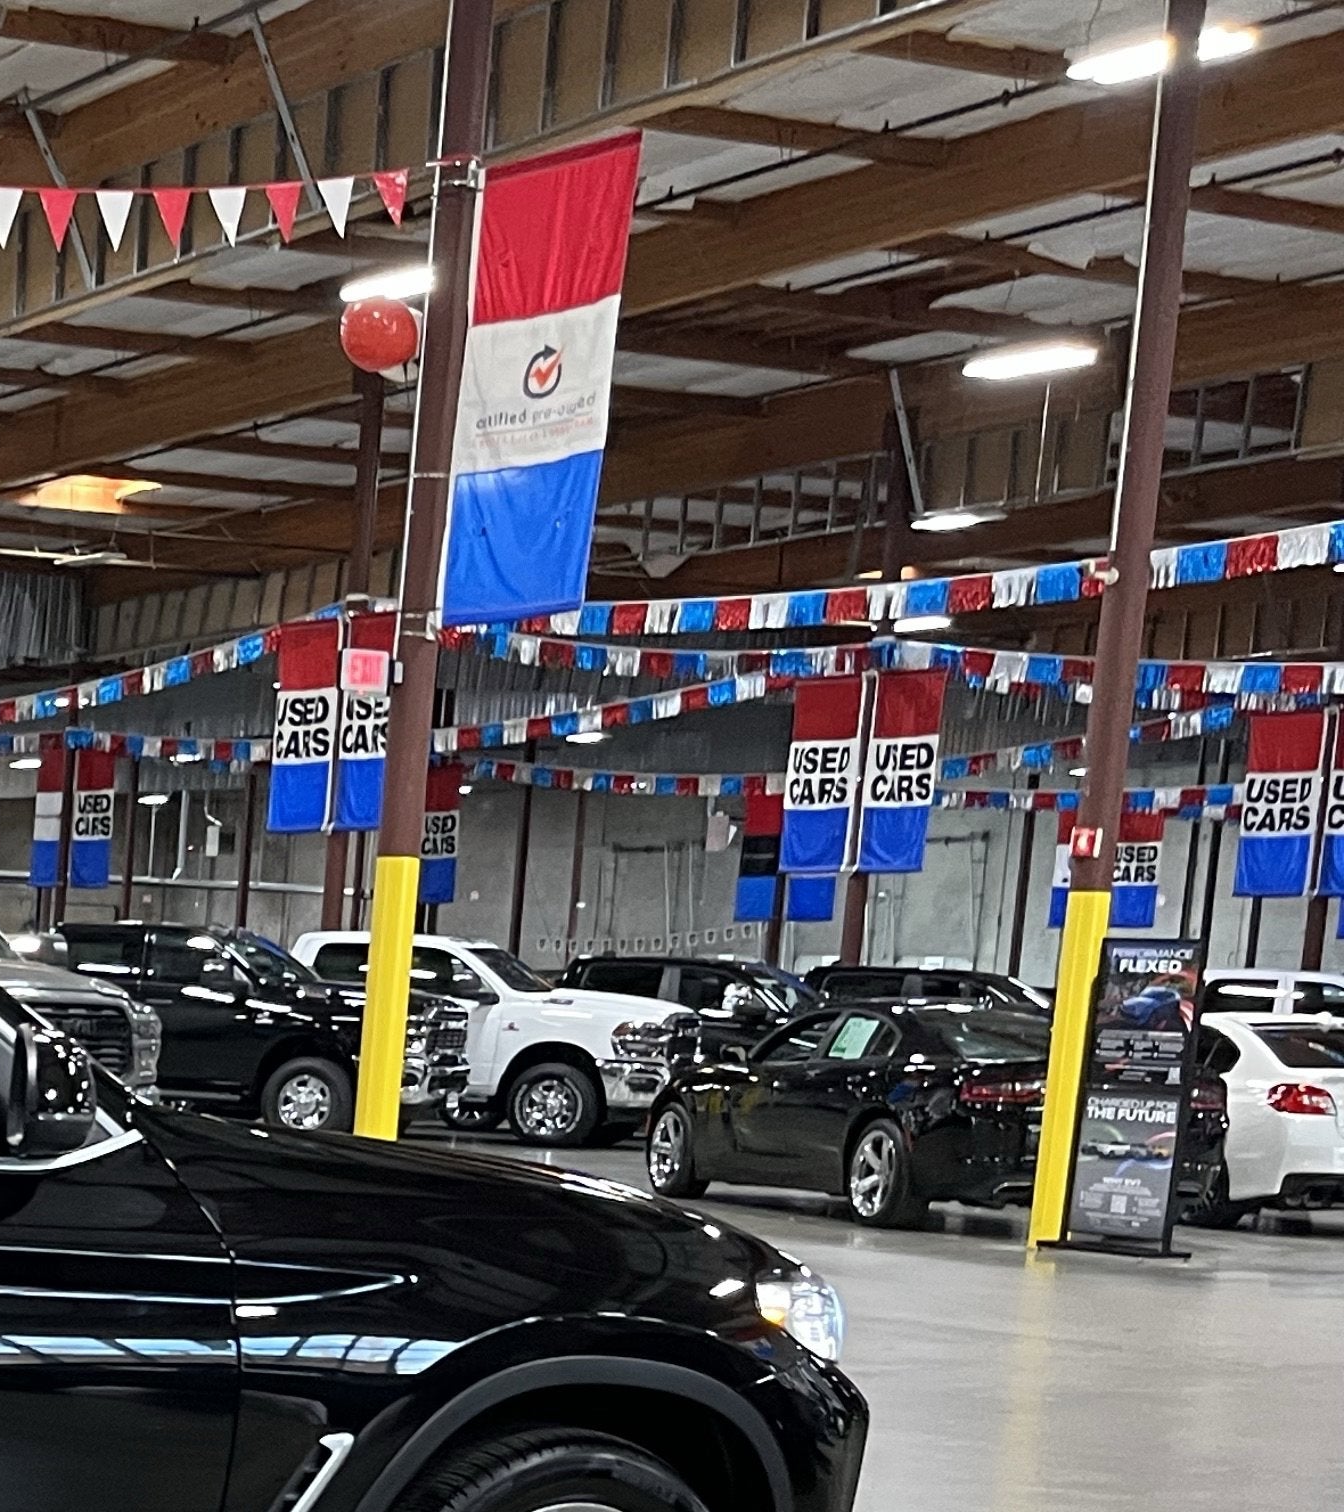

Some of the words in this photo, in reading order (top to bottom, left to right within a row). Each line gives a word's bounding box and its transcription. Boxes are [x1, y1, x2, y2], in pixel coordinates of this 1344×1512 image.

[277, 695, 329, 726] USED
[345, 694, 389, 721] USE
[276, 728, 329, 758] CARS
[793, 746, 851, 774] USED
[876, 743, 934, 771] USED
[789, 777, 848, 805] CARS
[870, 773, 931, 802] CARS
[1246, 777, 1313, 804] USED
[78, 794, 111, 814] USED
[1243, 805, 1311, 832] CARS
[1115, 845, 1158, 863] USED
[1113, 865, 1157, 882] CARS
[1112, 947, 1194, 960] PERFORMANCE
[1119, 958, 1183, 975] FLEXED
[1087, 1105, 1116, 1120] THE
[1118, 1107, 1176, 1123] FUTURE
